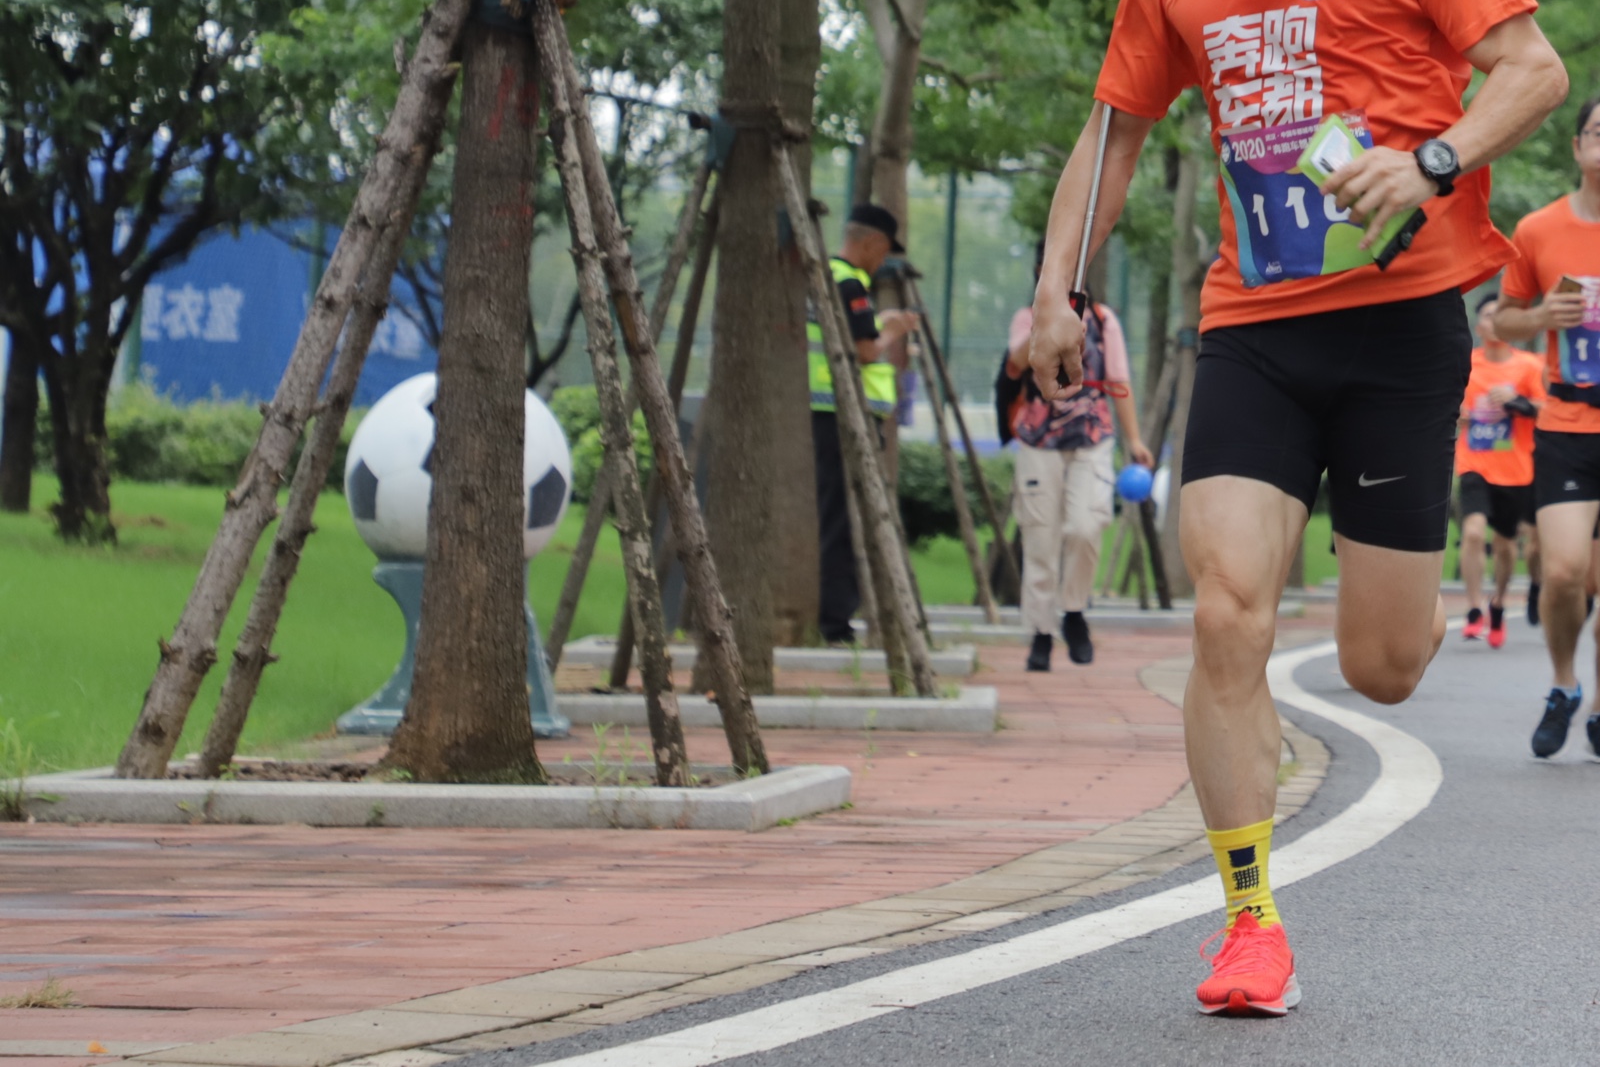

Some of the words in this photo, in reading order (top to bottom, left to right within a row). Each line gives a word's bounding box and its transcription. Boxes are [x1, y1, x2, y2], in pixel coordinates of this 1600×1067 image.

[1203, 5, 1318, 84] 奔跑
[1213, 66, 1323, 135] 车都
[1231, 137, 1266, 163] 2020
